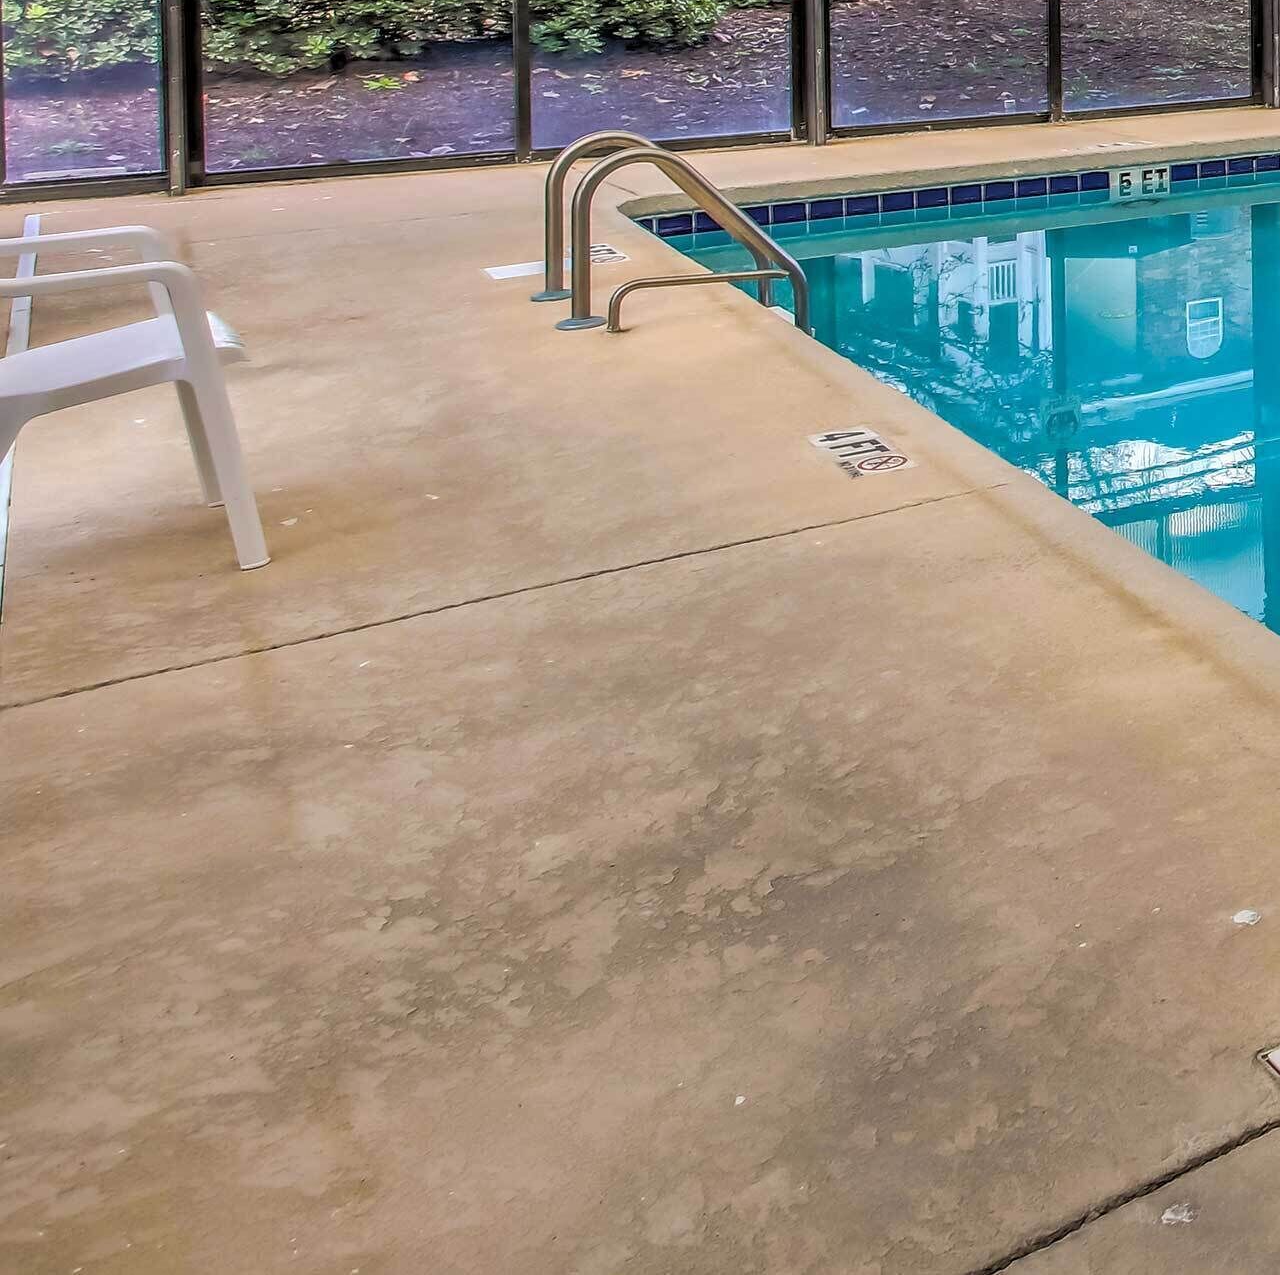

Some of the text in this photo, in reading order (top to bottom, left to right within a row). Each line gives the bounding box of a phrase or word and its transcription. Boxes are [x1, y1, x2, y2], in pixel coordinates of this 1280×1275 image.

[1119, 171, 1132, 188] 5
[819, 431, 890, 458] 4 FT
